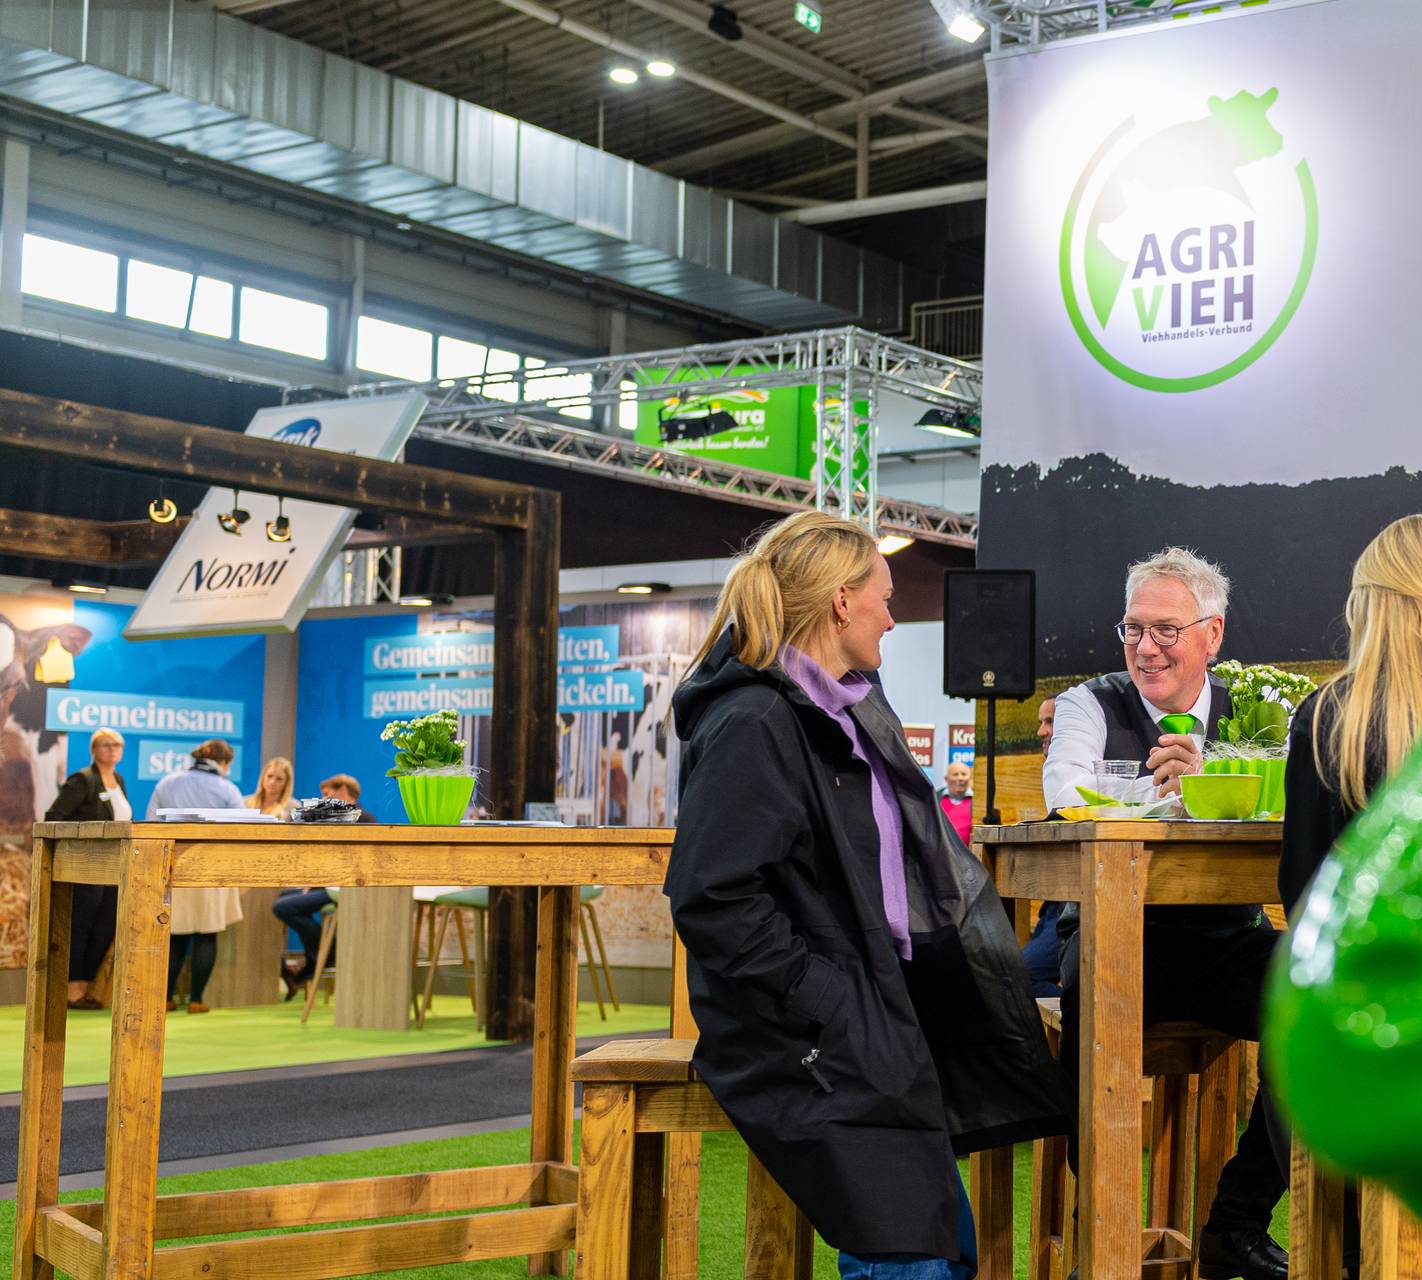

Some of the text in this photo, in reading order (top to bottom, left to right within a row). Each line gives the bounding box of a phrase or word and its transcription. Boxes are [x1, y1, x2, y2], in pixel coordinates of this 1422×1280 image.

[1132, 220, 1254, 280] AGRI
[1131, 274, 1254, 332] VIEH
[1141, 322, 1253, 343] Viehhandels-Verbund
[373, 634, 609, 668] Gemeinsam iten,
[57, 697, 233, 733] Gemeinsam
[371, 676, 636, 717] gemeinsam ickeln.
